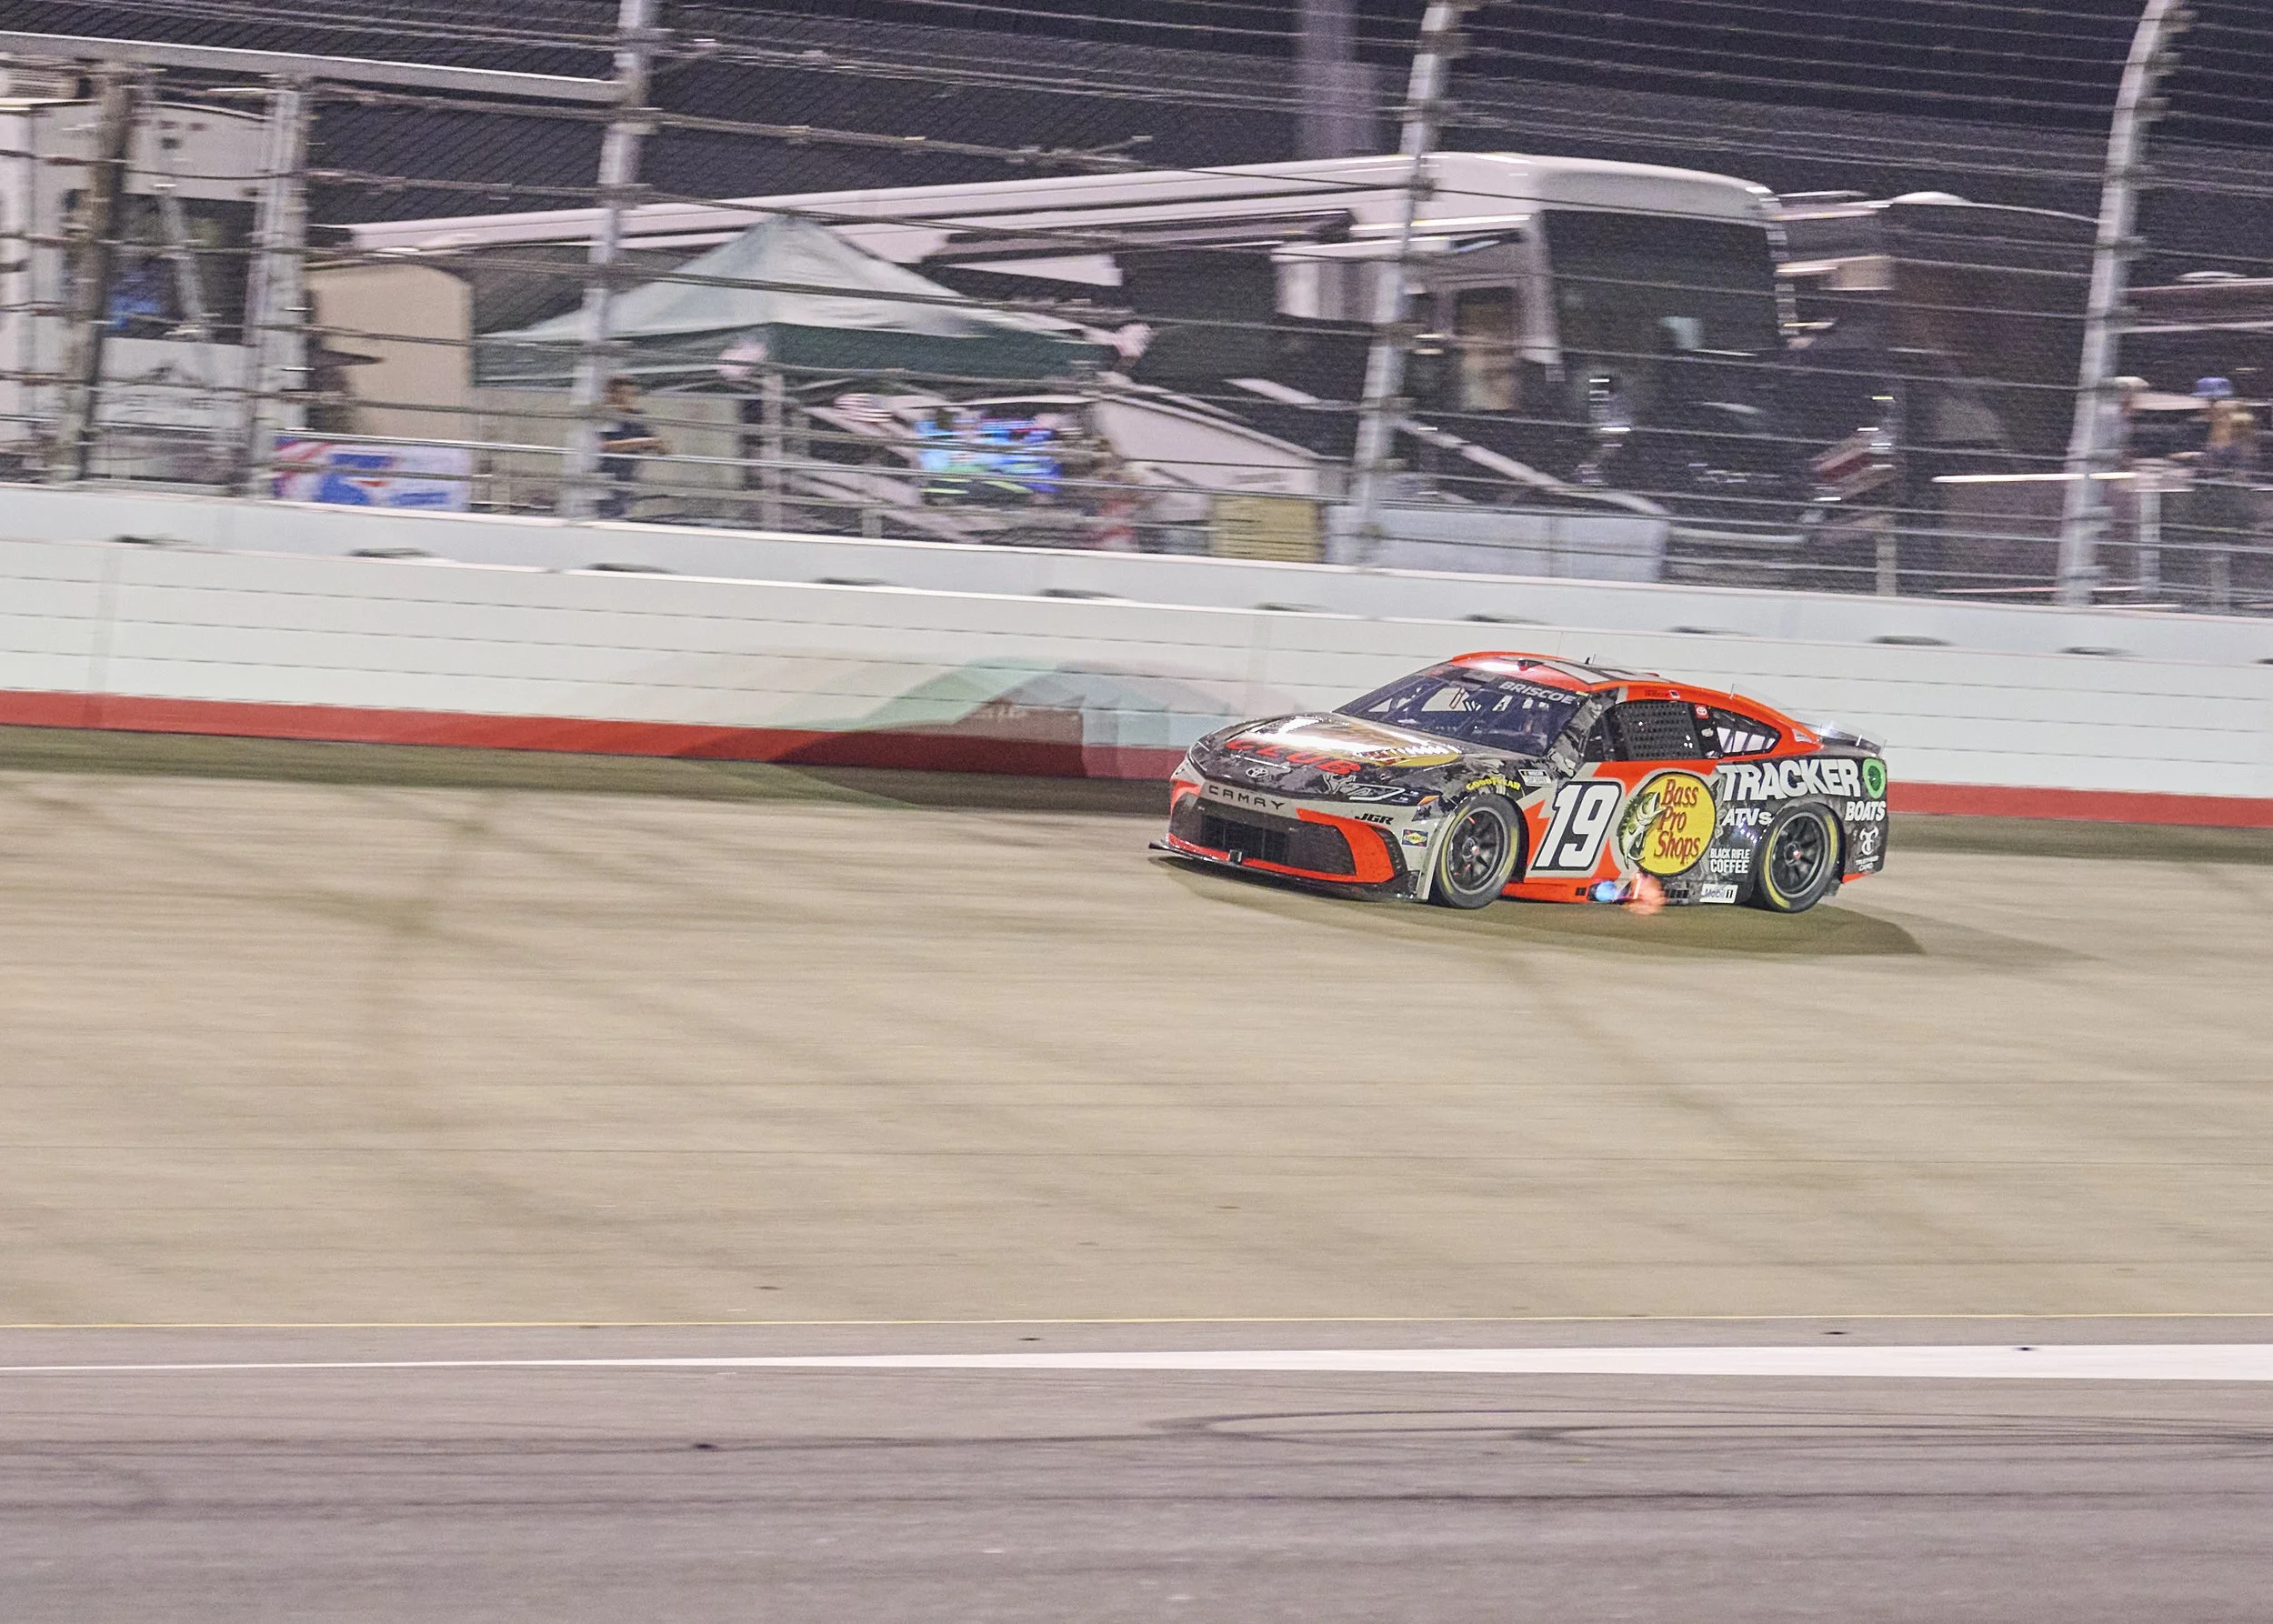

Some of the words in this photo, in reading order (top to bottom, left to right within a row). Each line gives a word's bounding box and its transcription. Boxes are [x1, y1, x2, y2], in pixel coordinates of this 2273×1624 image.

[1498, 681, 1577, 705] BRISCOE
[1225, 739, 1361, 775] CLUB
[1716, 758, 1861, 801] TRACKER
[1208, 785, 1285, 810] CAMRY
[1660, 778, 1699, 807] Bass
[1355, 813, 1393, 826] JGR
[1657, 806, 1687, 832] Pro
[1722, 807, 1773, 827] ATVs
[1845, 801, 1887, 821] BOATS
[1533, 783, 1620, 868] 19
[1653, 830, 1701, 866] Shops
[1709, 847, 1730, 859] BLACK
[1731, 848, 1751, 859] RIFLE
[1710, 859, 1750, 874] COFFEE
